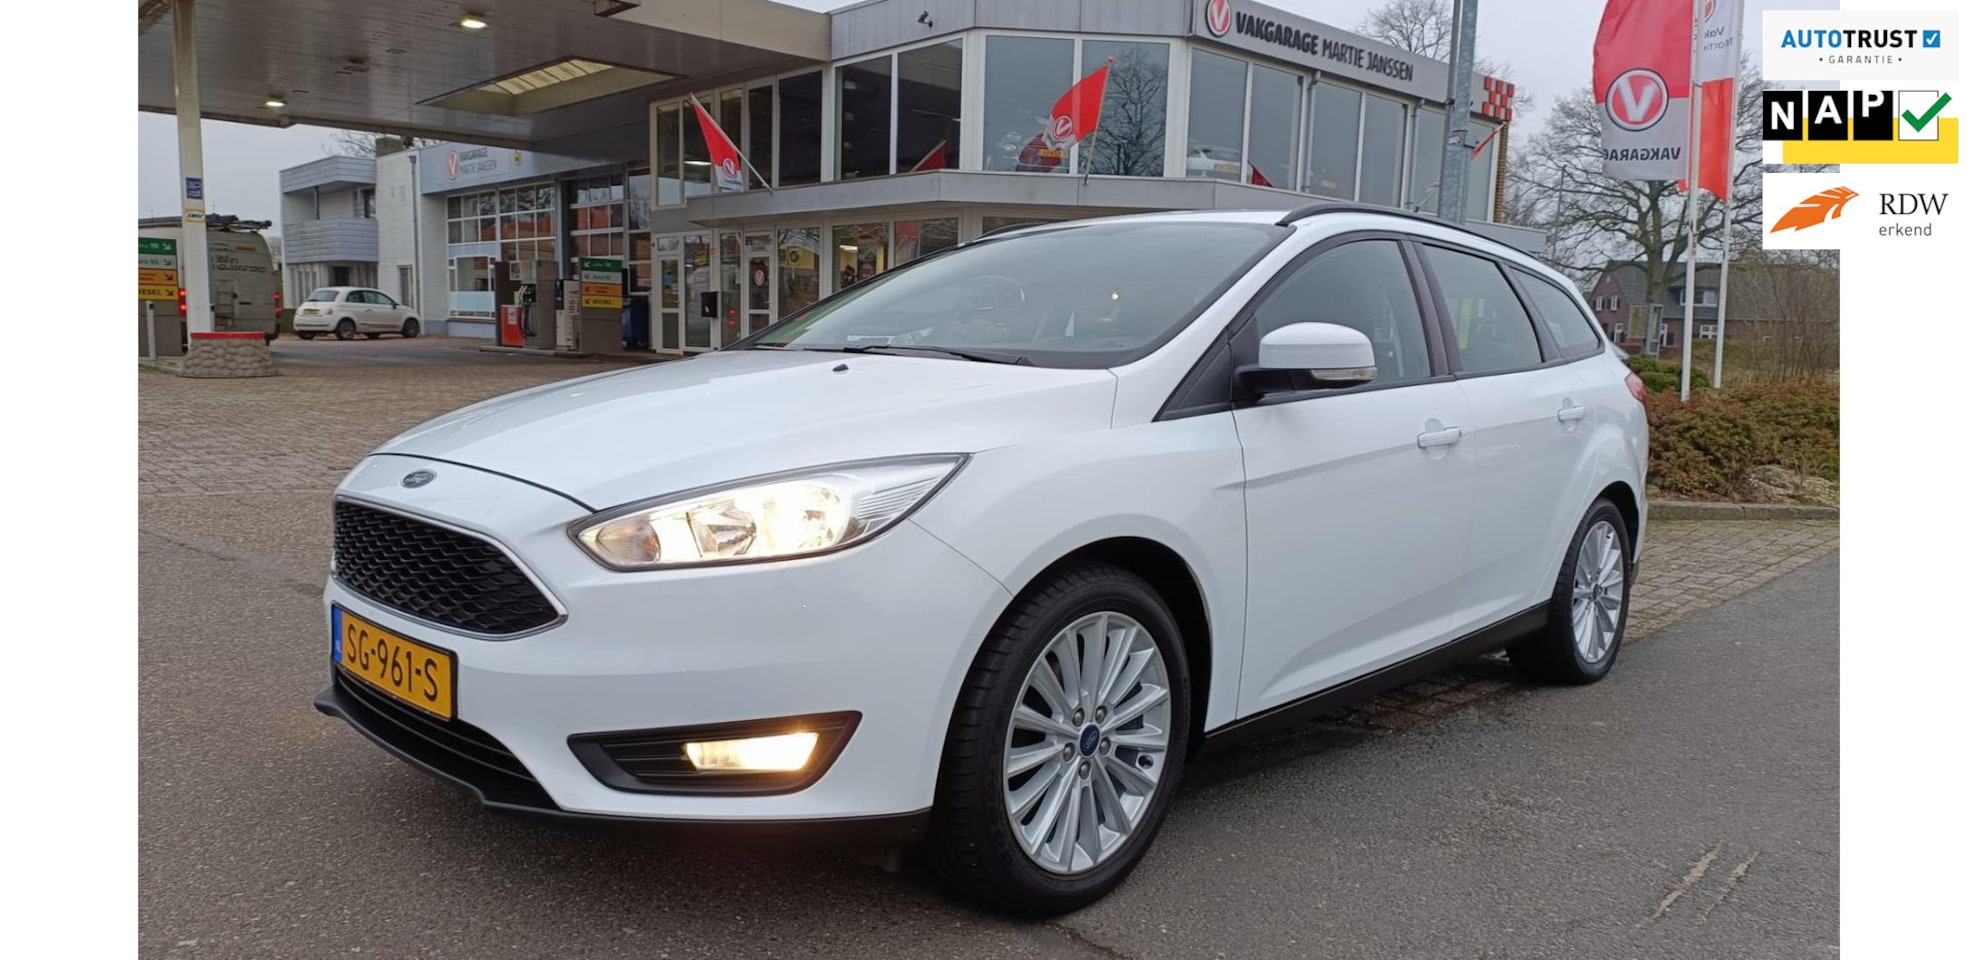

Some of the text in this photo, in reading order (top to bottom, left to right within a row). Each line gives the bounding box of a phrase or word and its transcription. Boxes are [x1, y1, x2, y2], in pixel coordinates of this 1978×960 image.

[1236, 11, 1414, 82] VAKGARAGE MARTIE JANSSEN
[346, 622, 440, 703] SG-961-S
